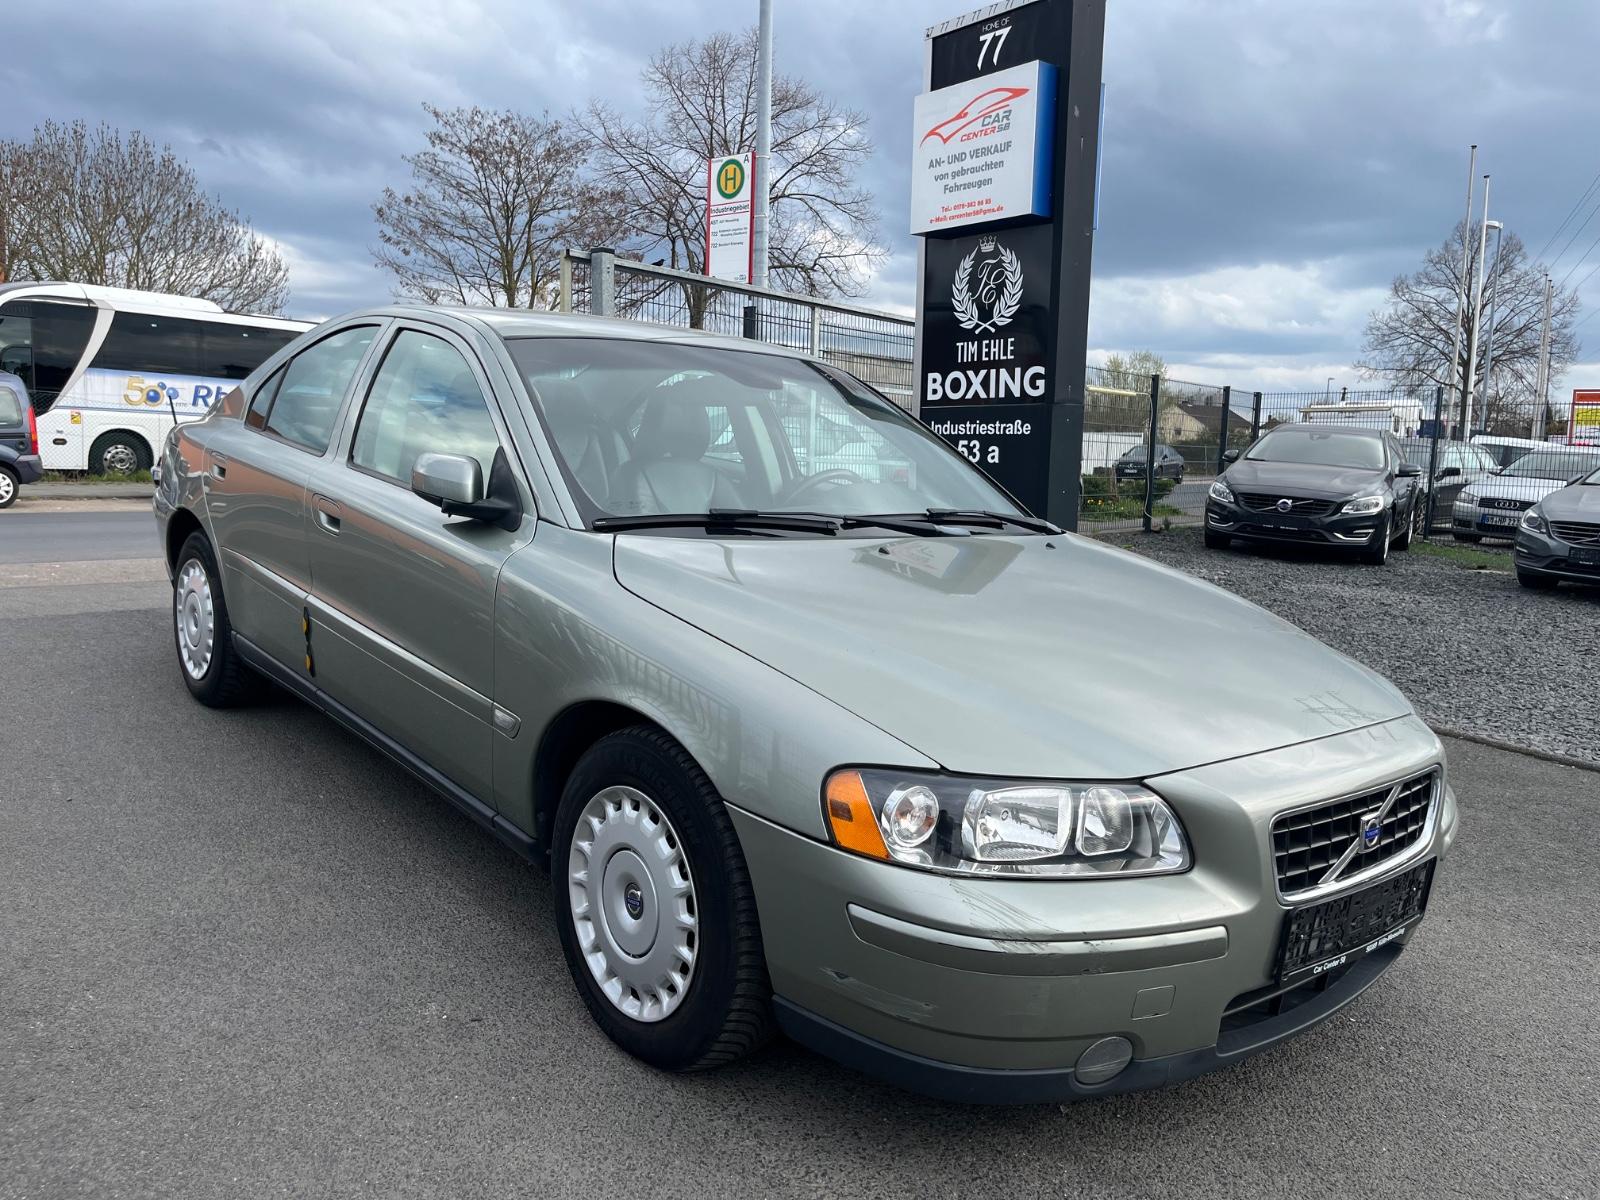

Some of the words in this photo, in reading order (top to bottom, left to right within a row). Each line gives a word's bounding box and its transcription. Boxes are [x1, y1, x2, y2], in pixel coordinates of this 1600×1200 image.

[982, 20, 1000, 32] HOME
[1000, 17, 1010, 26] OF
[977, 26, 1012, 71] 77
[981, 109, 1012, 127] CAR
[928, 157, 945, 169] AN-
[947, 152, 967, 165] UND
[969, 141, 1012, 159] VERKAUF
[724, 167, 736, 191] H
[934, 172, 949, 182] von
[950, 160, 1004, 180] gebrauchten
[943, 177, 992, 194] Fahrzeugen
[711, 204, 749, 214] Industriegebiet
[956, 341, 978, 363] TIM
[982, 338, 1015, 361] EHLE
[926, 365, 1046, 401] BOXING
[931, 419, 1031, 435] Industriestraße
[957, 440, 980, 463] 53
[987, 445, 999, 463] a
